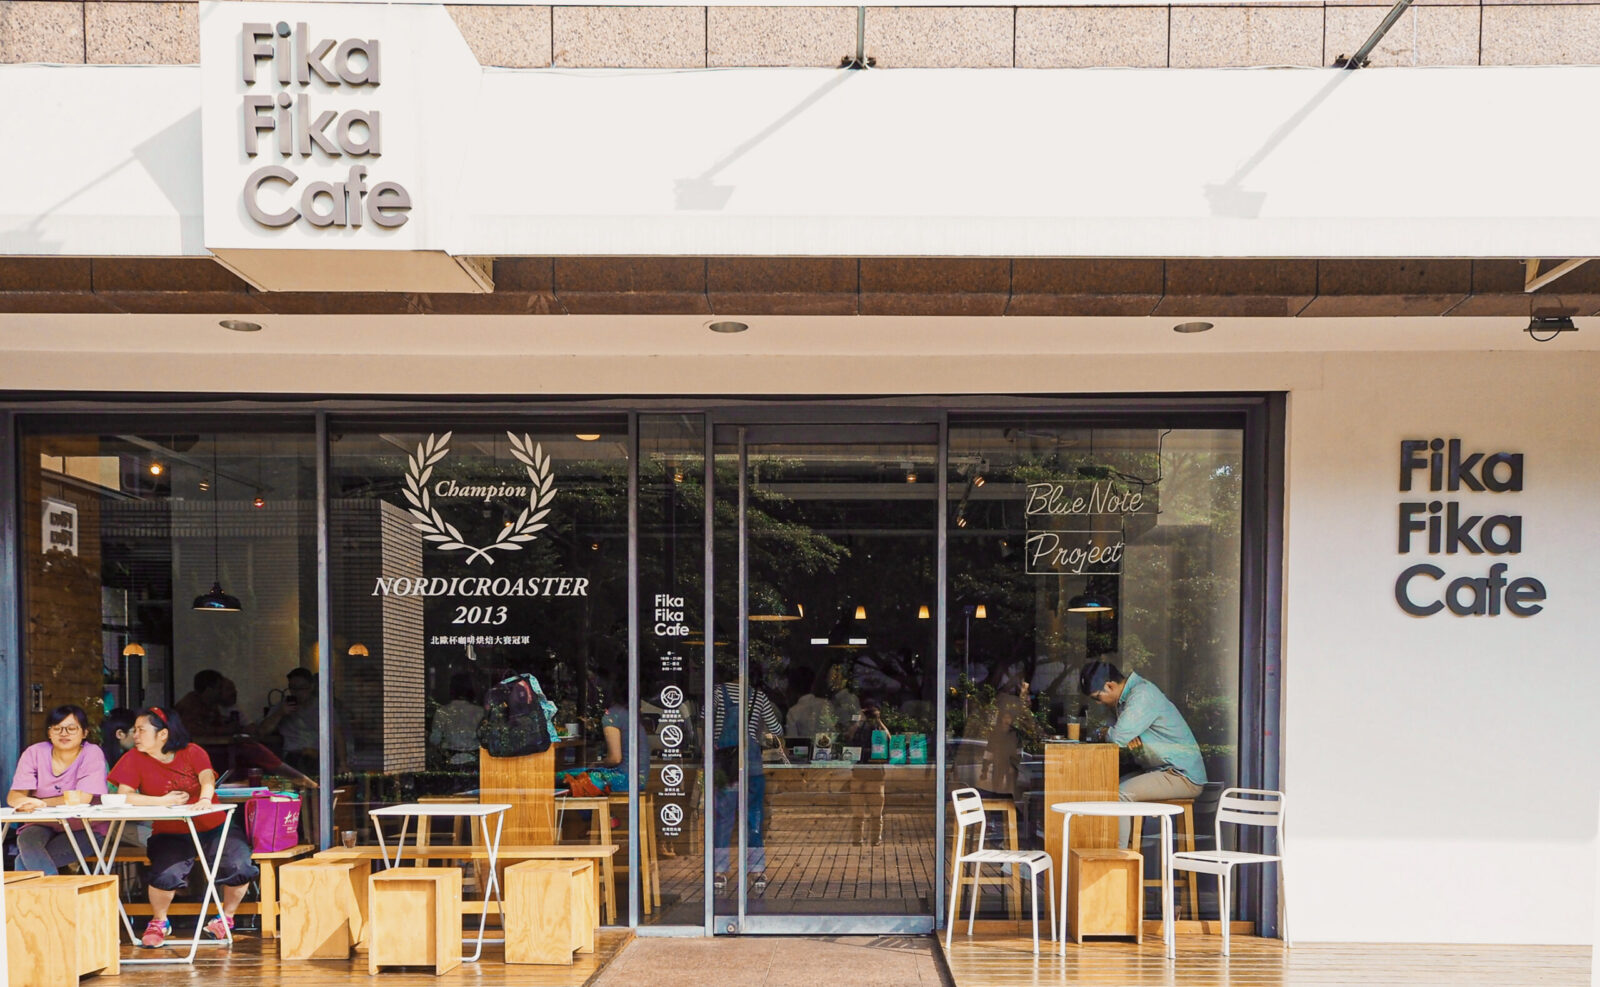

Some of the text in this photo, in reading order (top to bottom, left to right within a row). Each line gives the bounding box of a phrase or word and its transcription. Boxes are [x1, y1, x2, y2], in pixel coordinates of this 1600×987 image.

[242, 21, 381, 87] Fika
[243, 92, 382, 158] Fika
[243, 164, 412, 229] Cafe
[1399, 438, 1524, 493] Fika
[434, 480, 527, 502] Champion
[1026, 481, 1144, 515] Blue Note
[1398, 500, 1523, 555] Fika
[1026, 532, 1125, 575] Project
[371, 577, 590, 597] NORDICROASTER
[655, 594, 684, 607] Fika
[1395, 562, 1547, 618] Cafe
[451, 605, 509, 625] 2013
[654, 622, 690, 636] Cafe
[655, 608, 684, 622] Fika
